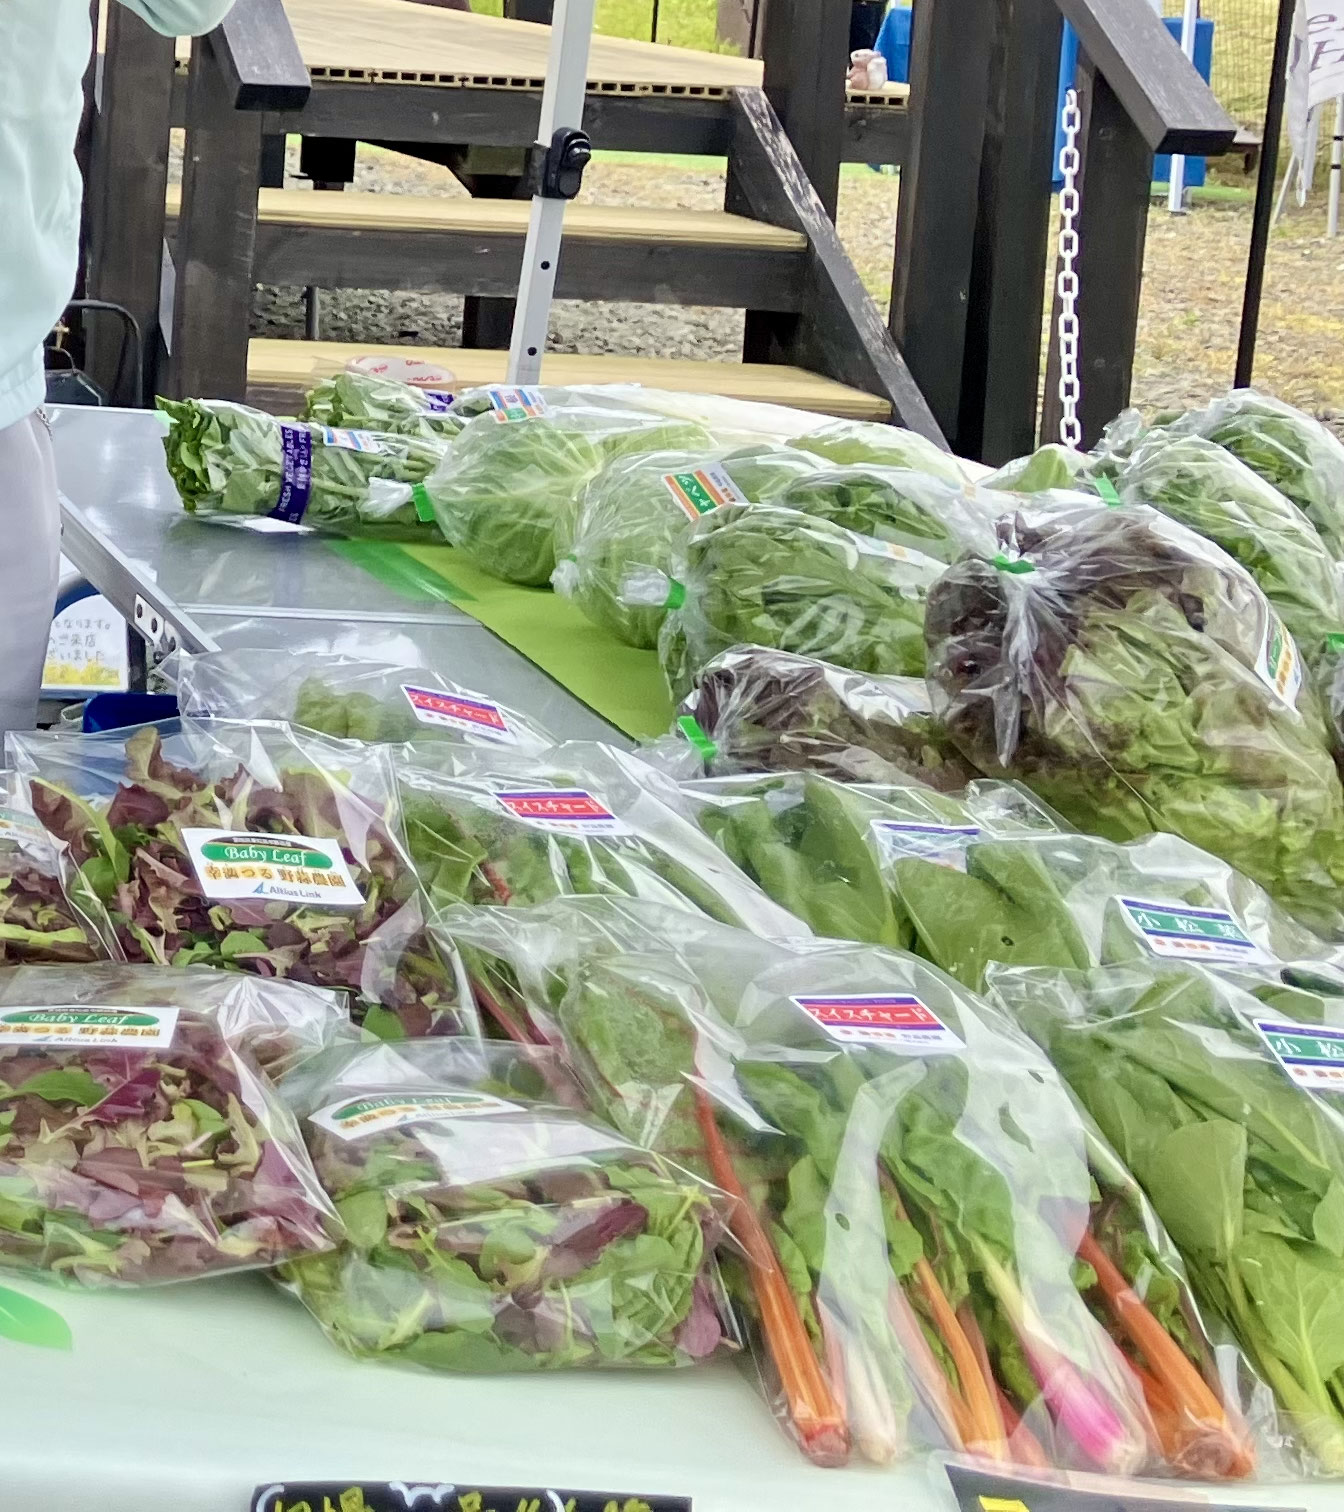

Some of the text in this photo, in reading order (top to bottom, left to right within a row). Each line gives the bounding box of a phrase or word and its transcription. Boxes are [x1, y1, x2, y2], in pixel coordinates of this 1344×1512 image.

[224, 844, 307, 866] Baby Leaf
[299, 889, 322, 899] Link
[28, 1012, 130, 1026] Baby Leaf
[809, 1006, 930, 1022] スイスチャード
